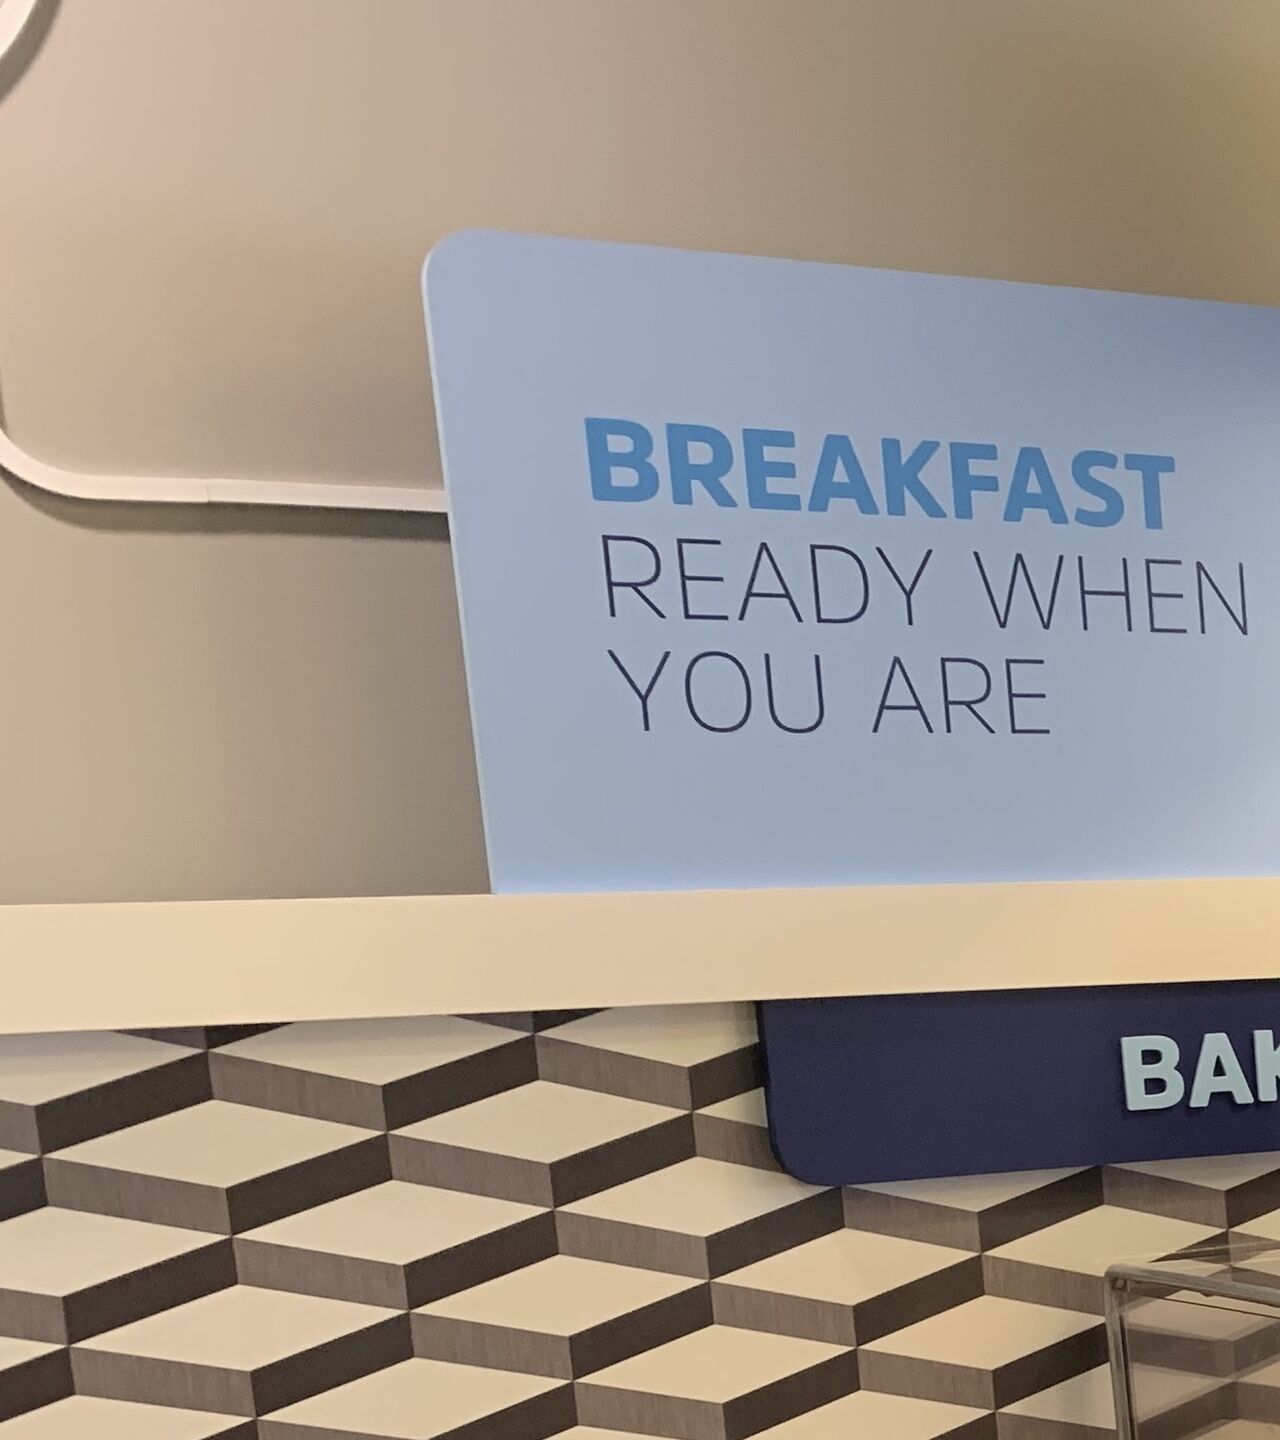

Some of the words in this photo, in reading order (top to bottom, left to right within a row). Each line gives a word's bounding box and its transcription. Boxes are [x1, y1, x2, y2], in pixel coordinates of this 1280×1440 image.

[584, 417, 1176, 530] BREAKFAST
[602, 534, 932, 626] READY
[973, 551, 1248, 636] WHEN
[607, 649, 824, 734] YOU
[872, 656, 1051, 735] ARE
